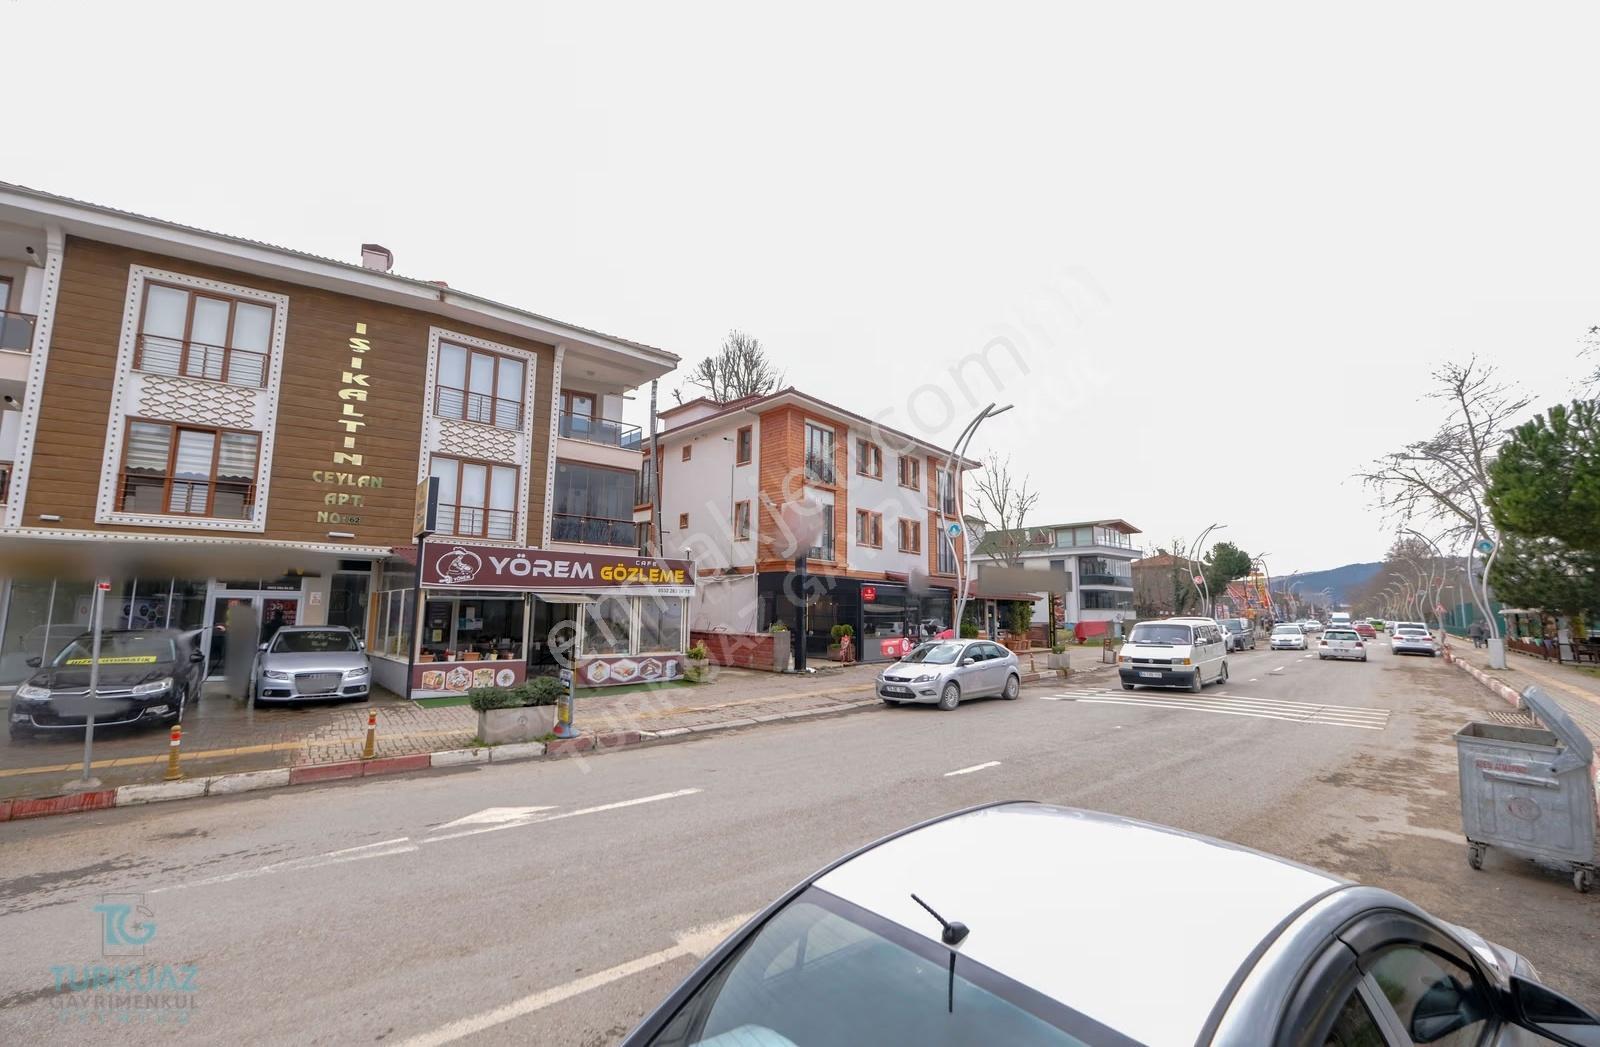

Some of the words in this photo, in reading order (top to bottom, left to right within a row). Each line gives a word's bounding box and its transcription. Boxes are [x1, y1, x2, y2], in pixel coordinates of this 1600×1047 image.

[312, 470, 383, 488] CEYLAN
[324, 492, 364, 508] APT.
[488, 553, 594, 580] YÖREM
[600, 563, 685, 583] GÖZLEME
